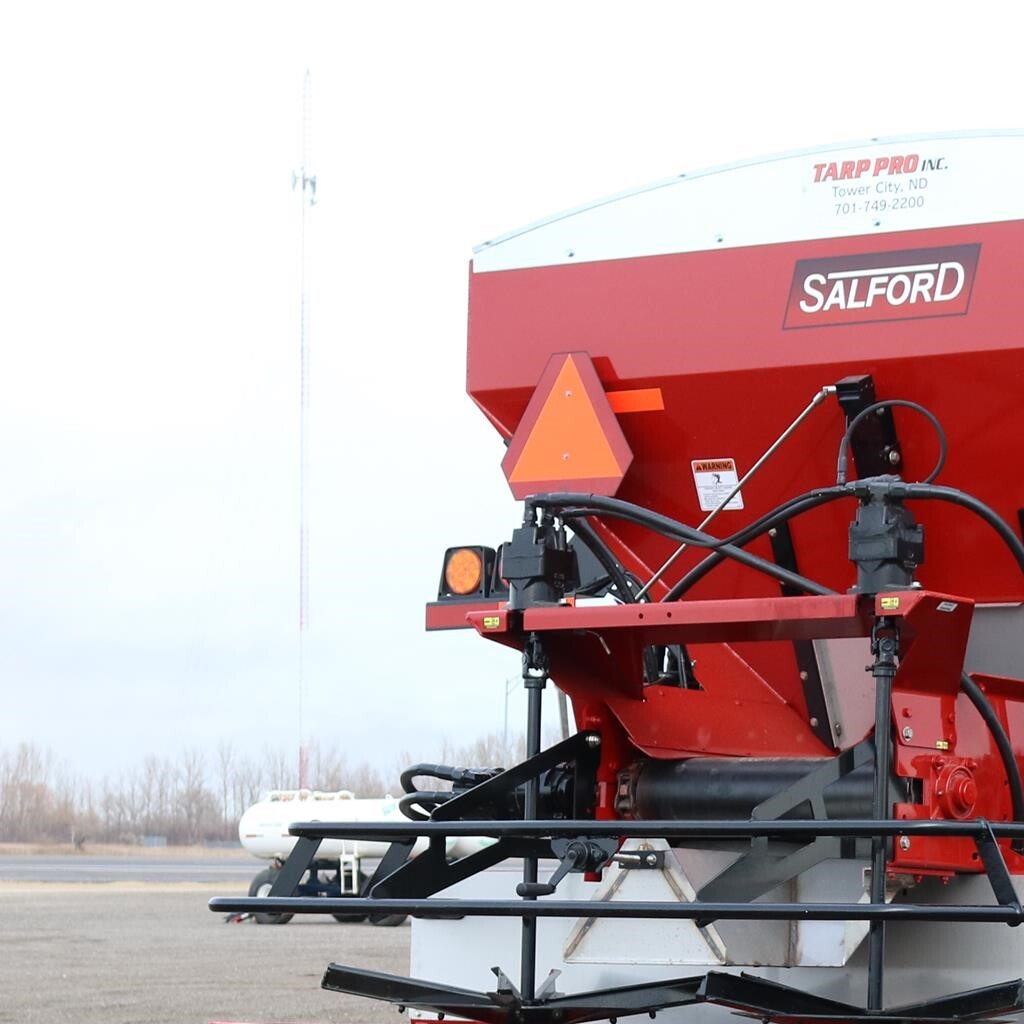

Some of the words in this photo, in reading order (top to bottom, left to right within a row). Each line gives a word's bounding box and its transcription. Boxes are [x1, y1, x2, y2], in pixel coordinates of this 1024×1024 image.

[813, 159, 870, 182] TARP
[872, 154, 919, 177] PRO
[921, 157, 948, 172] INC.
[832, 185, 870, 197] Tower
[909, 177, 928, 190] ND
[835, 195, 925, 216] 701-749-2200
[799, 261, 965, 313] SALFORD
[702, 462, 732, 471] WARNING
